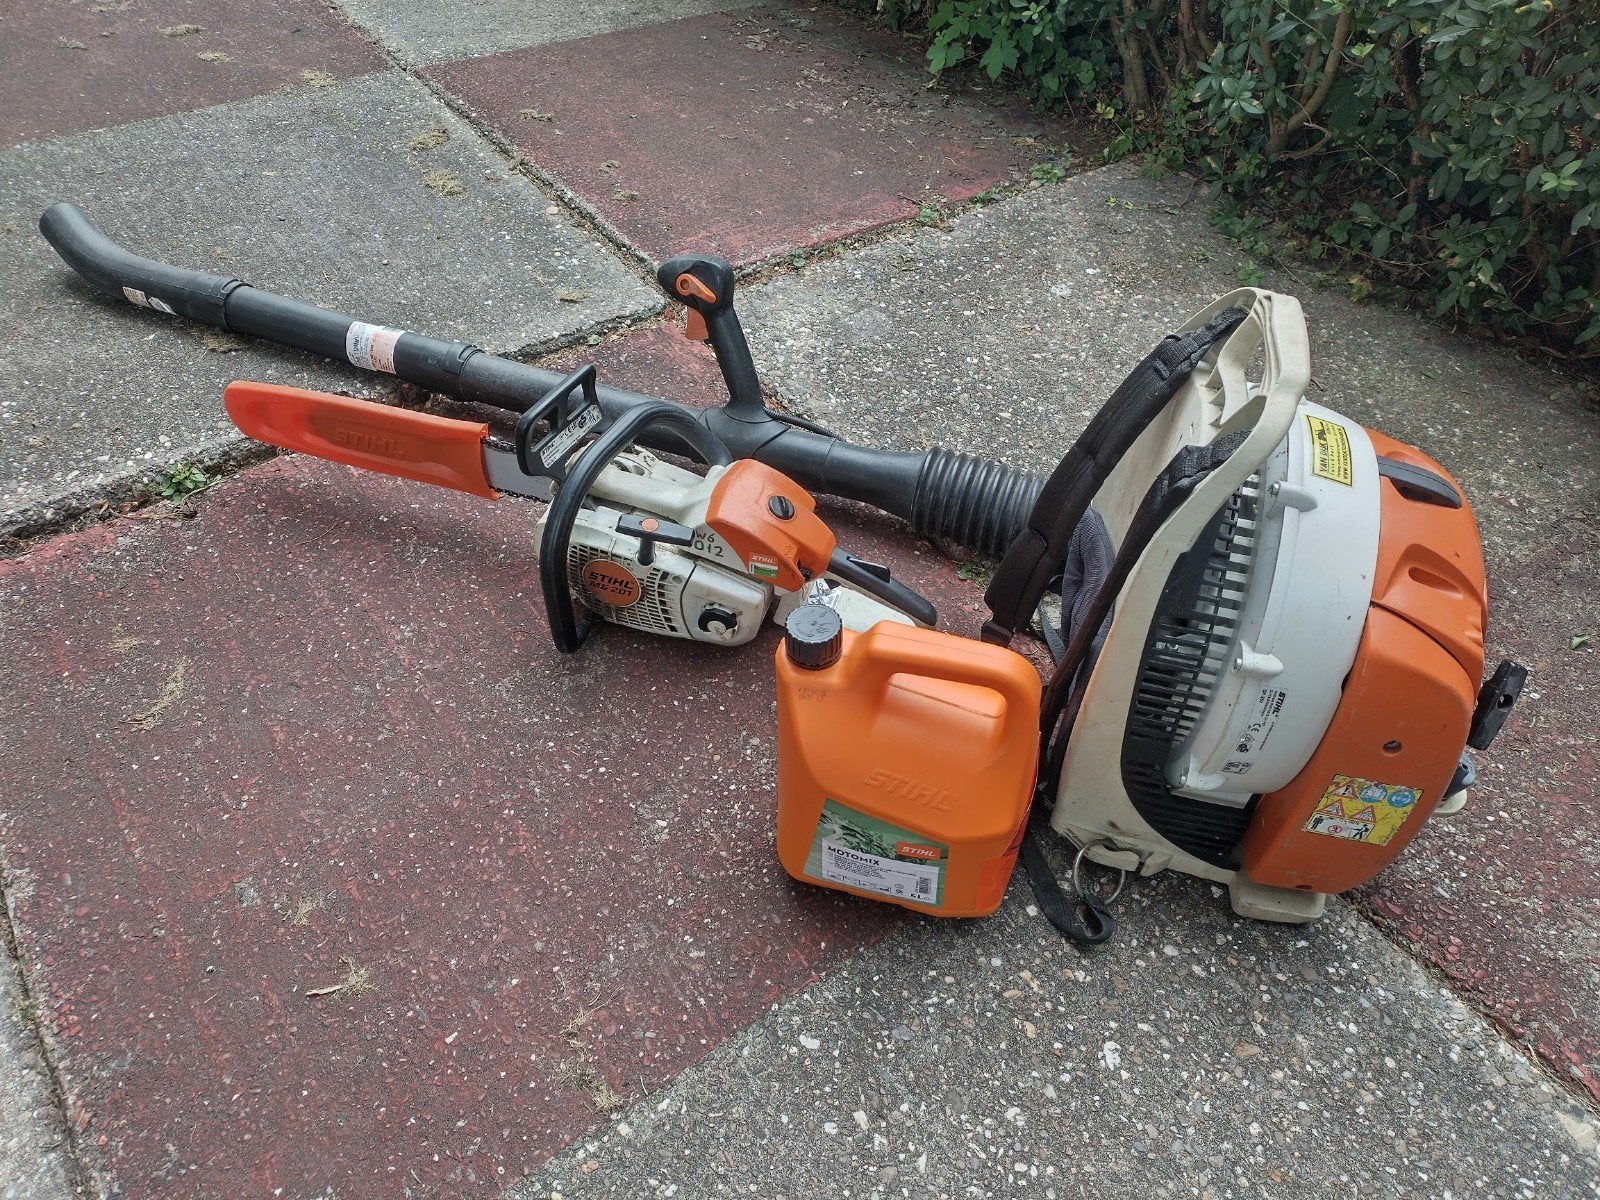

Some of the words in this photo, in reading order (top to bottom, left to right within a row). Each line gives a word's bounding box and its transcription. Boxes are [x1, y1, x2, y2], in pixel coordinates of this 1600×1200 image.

[333, 428, 405, 454] STIHL
[1319, 457, 1328, 472] VAN
[693, 540, 724, 558] 012
[751, 555, 776, 564] STIHL
[588, 571, 634, 591] STIHL
[589, 581, 609, 591] MS
[610, 586, 632, 597] 201
[1272, 691, 1287, 715] STIHL
[863, 768, 952, 813] STIHL
[827, 845, 880, 866] MOTOMIX
[901, 846, 936, 857] STIHL
